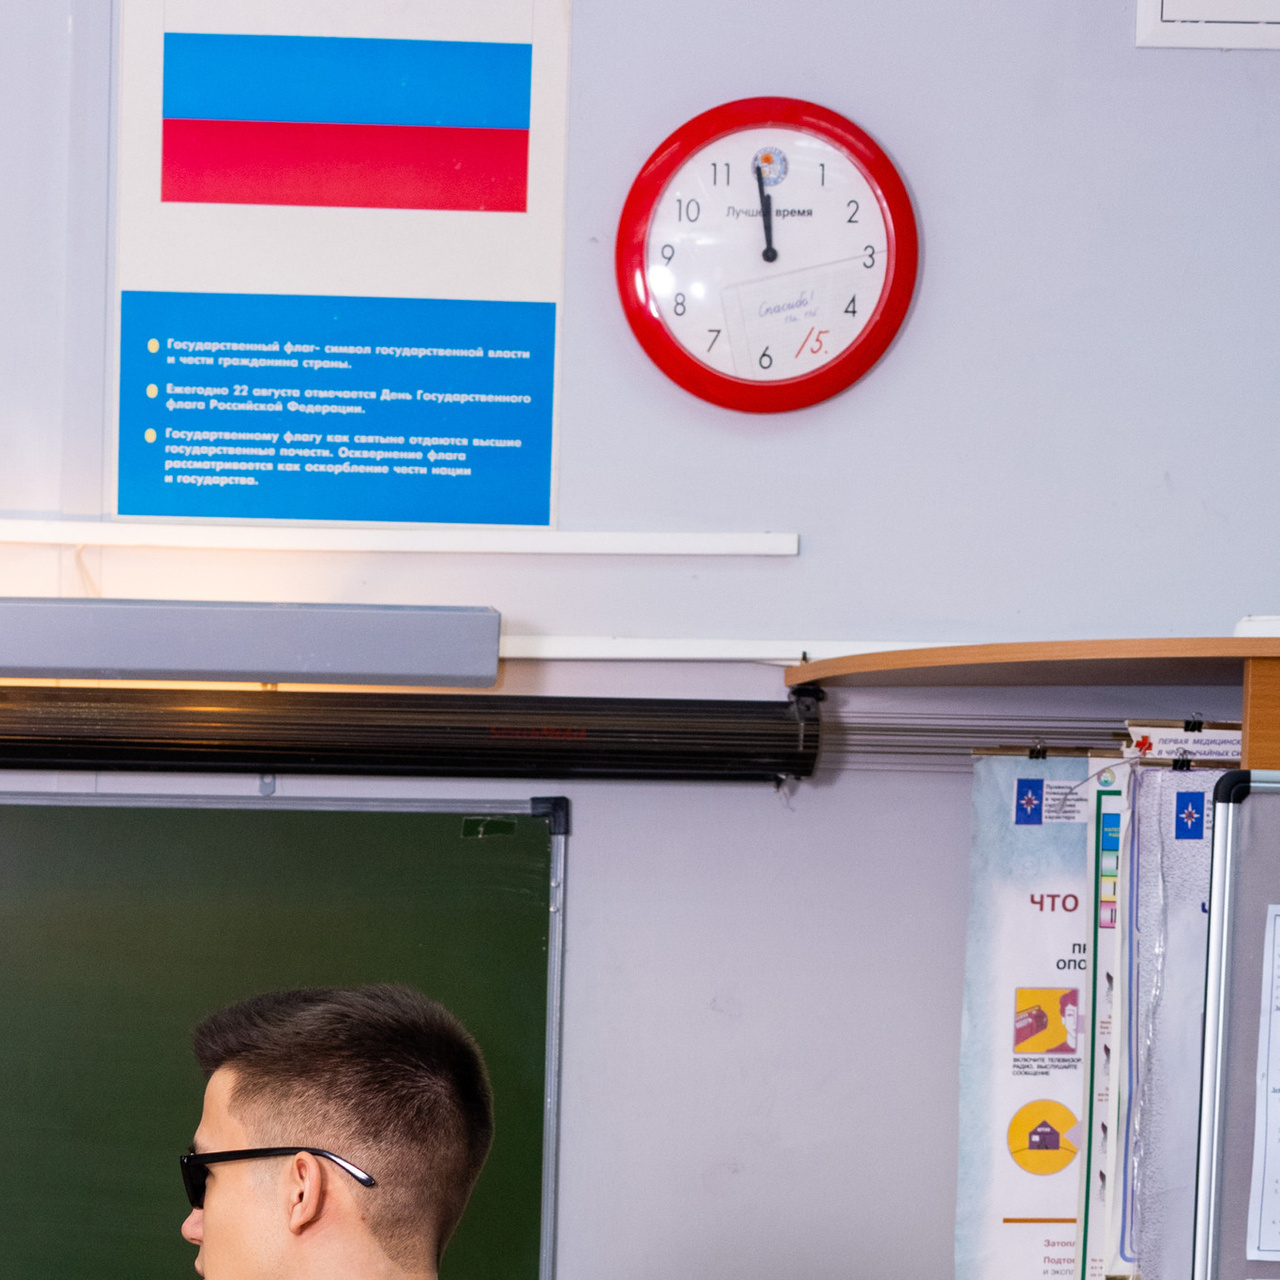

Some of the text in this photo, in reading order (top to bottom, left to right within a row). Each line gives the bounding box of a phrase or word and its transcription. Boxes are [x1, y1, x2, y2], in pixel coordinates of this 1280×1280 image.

[711, 162, 730, 187] 11
[819, 162, 826, 187] 1
[676, 198, 701, 222] 10
[726, 206, 813, 219] Лучш время
[846, 199, 859, 223] 2
[661, 243, 675, 266] 9
[863, 244, 875, 269] 3
[673, 292, 686, 316] 8
[844, 293, 857, 317] 4
[167, 337, 529, 359] Государственный флаг- символ государственной власти
[707, 329, 721, 352] 7
[167, 355, 352, 371] и чести гражданина страны.
[758, 345, 773, 369] 6
[166, 382, 531, 405] Ежегодно 22 августа отмечается День Государственного
[166, 397, 365, 416] флага Российской Федерации.
[283, 430, 321, 444] флагу
[327, 433, 349, 443] как
[354, 434, 404, 444] святыне
[409, 435, 468, 447] отдаются
[473, 437, 521, 447] высшие
[165, 444, 465, 463] государственные почести. Осквернение флага
[165, 459, 470, 477] рассматривается как оскорбление чести нации
[165, 474, 259, 488] и государства.
[1030, 894, 1079, 912] ЧТО
